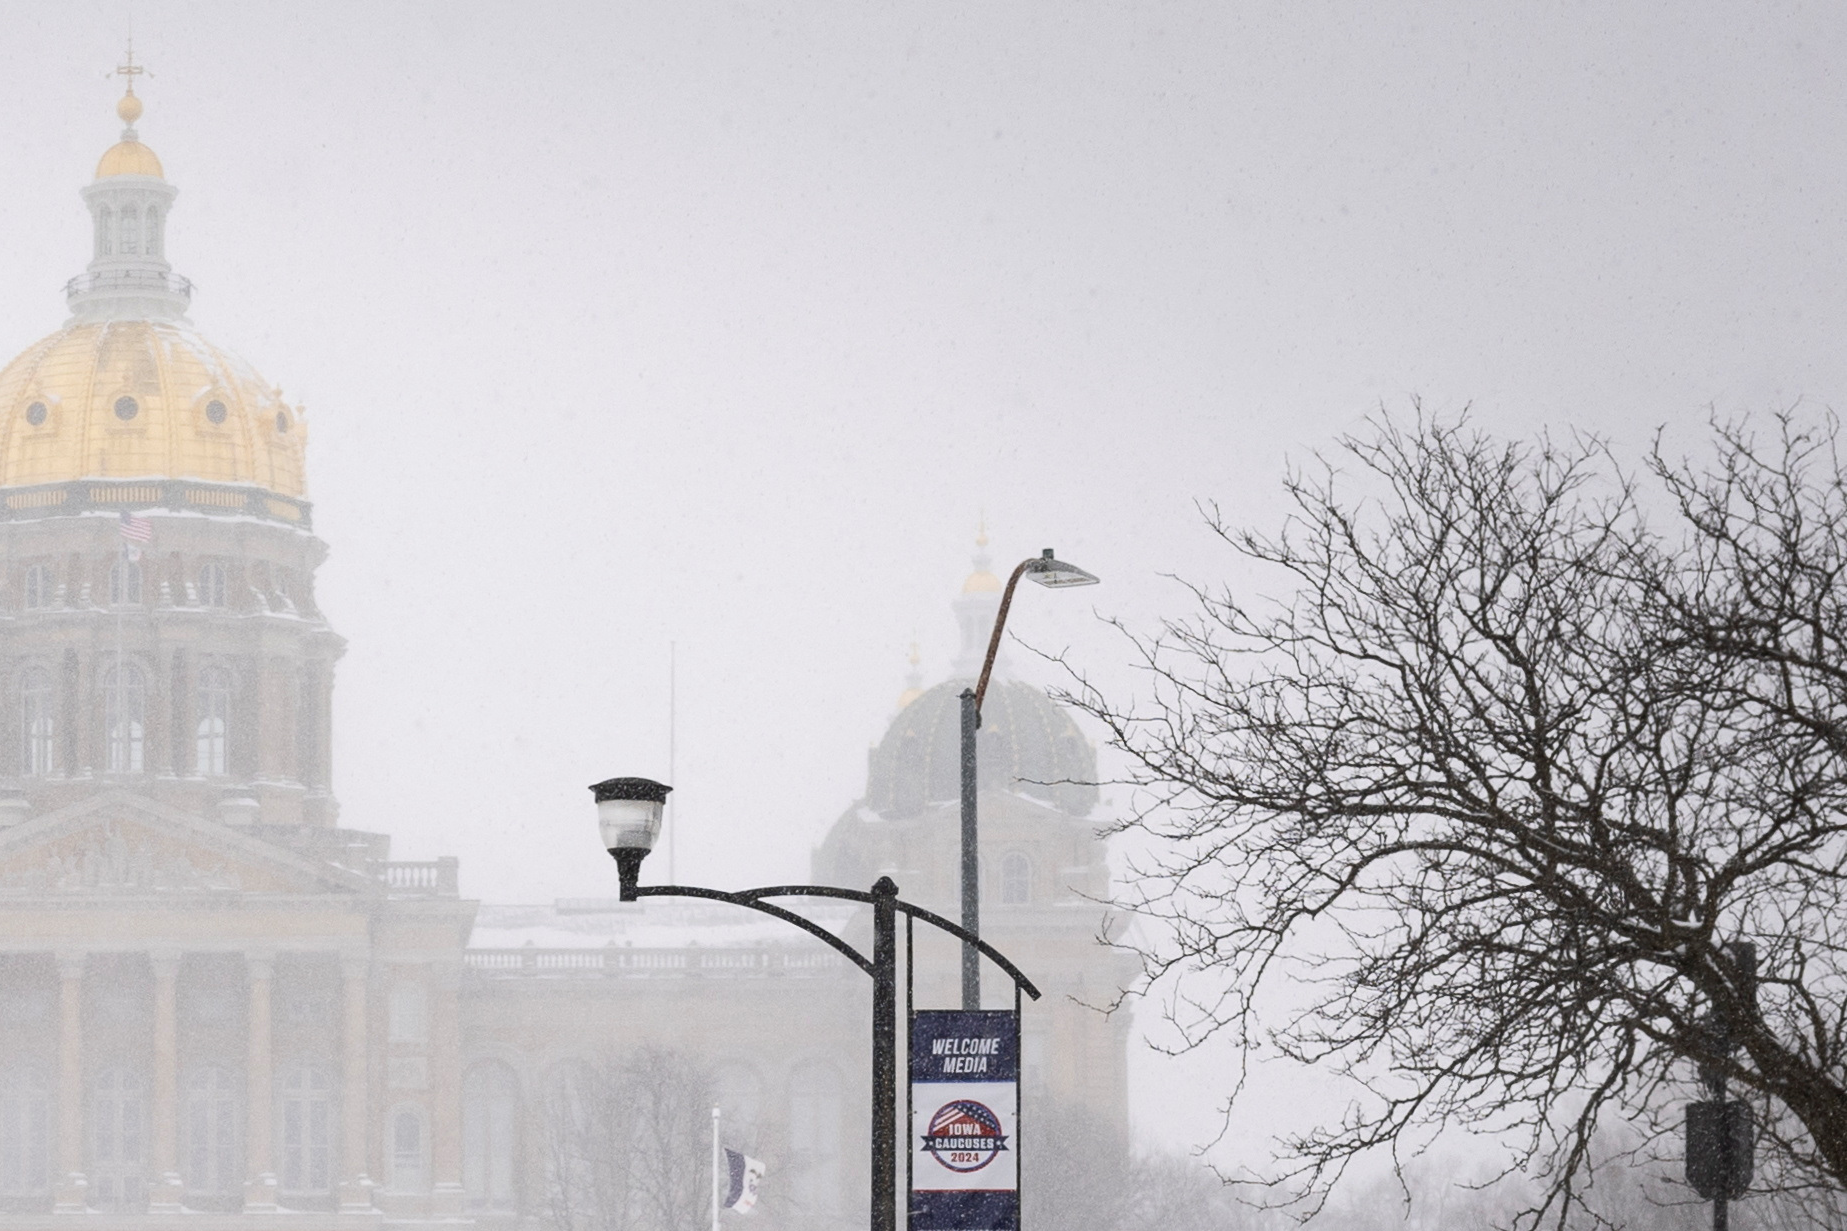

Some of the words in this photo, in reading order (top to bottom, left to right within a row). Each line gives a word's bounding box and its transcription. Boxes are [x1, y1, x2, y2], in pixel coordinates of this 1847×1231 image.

[932, 1038, 1001, 1055] WELCOME
[943, 1057, 988, 1073] MEDIA
[949, 1123, 981, 1136] IOWA
[935, 1137, 994, 1149] CAUCUSES
[950, 1152, 980, 1163] 2024
